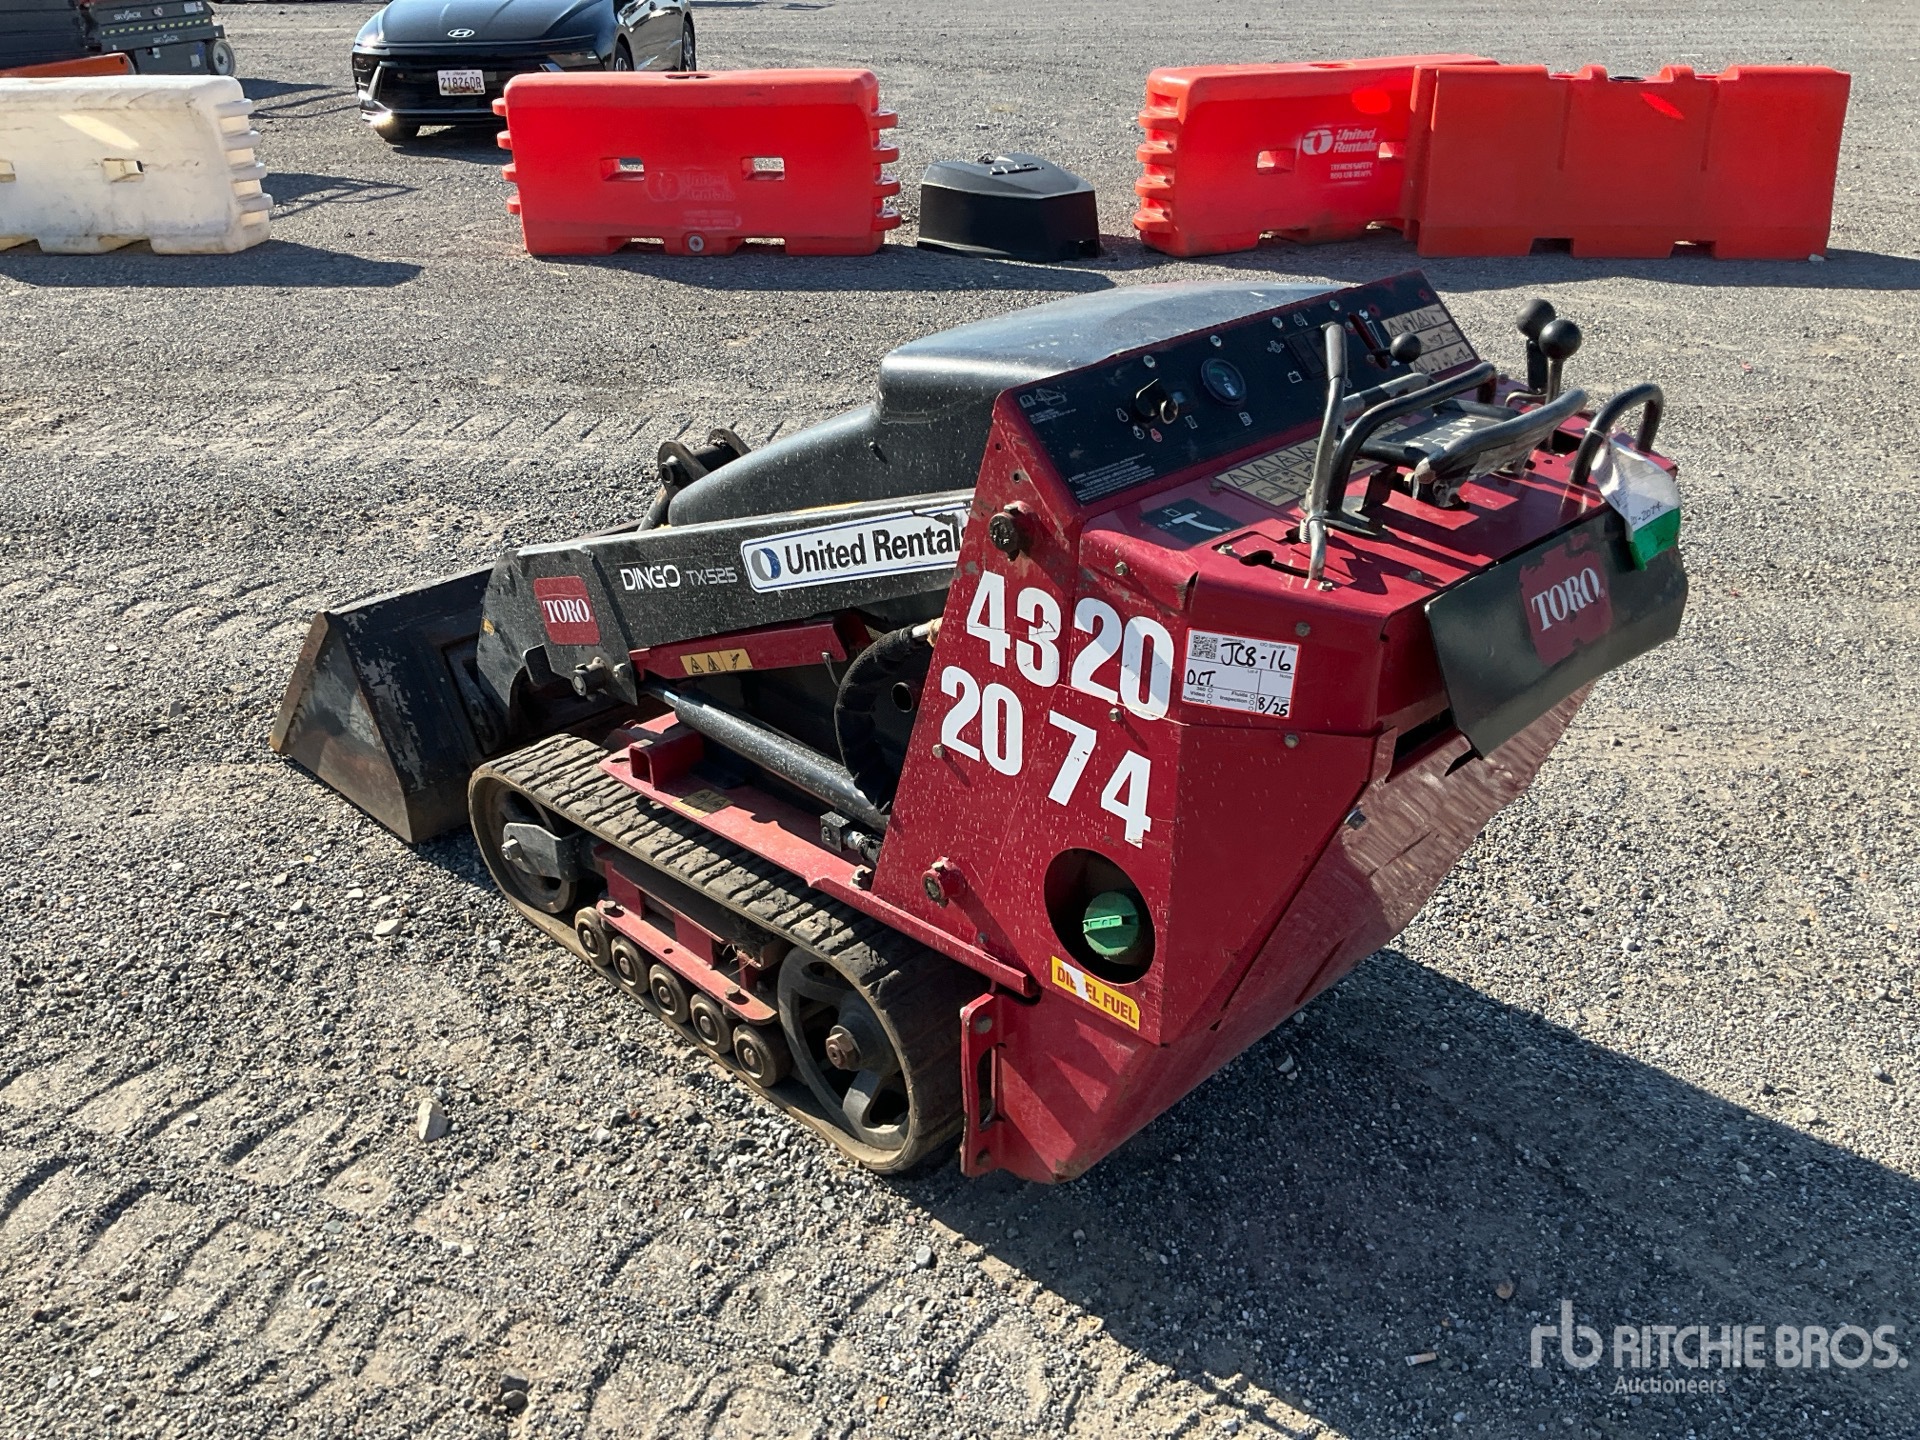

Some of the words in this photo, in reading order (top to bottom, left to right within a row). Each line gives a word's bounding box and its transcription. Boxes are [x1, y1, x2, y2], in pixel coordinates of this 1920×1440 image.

[1333, 140, 1377, 153] Rentals
[1336, 128, 1377, 141] United
[784, 532, 867, 575] United
[620, 564, 681, 591] DINGO
[686, 566, 739, 586] TX525
[542, 598, 590, 623] TORO
[1531, 567, 1600, 632] TORO
[1258, 696, 1290, 716] 8/25
[1057, 966, 1100, 1004] DIEEL
[1103, 991, 1137, 1024] FUEL
